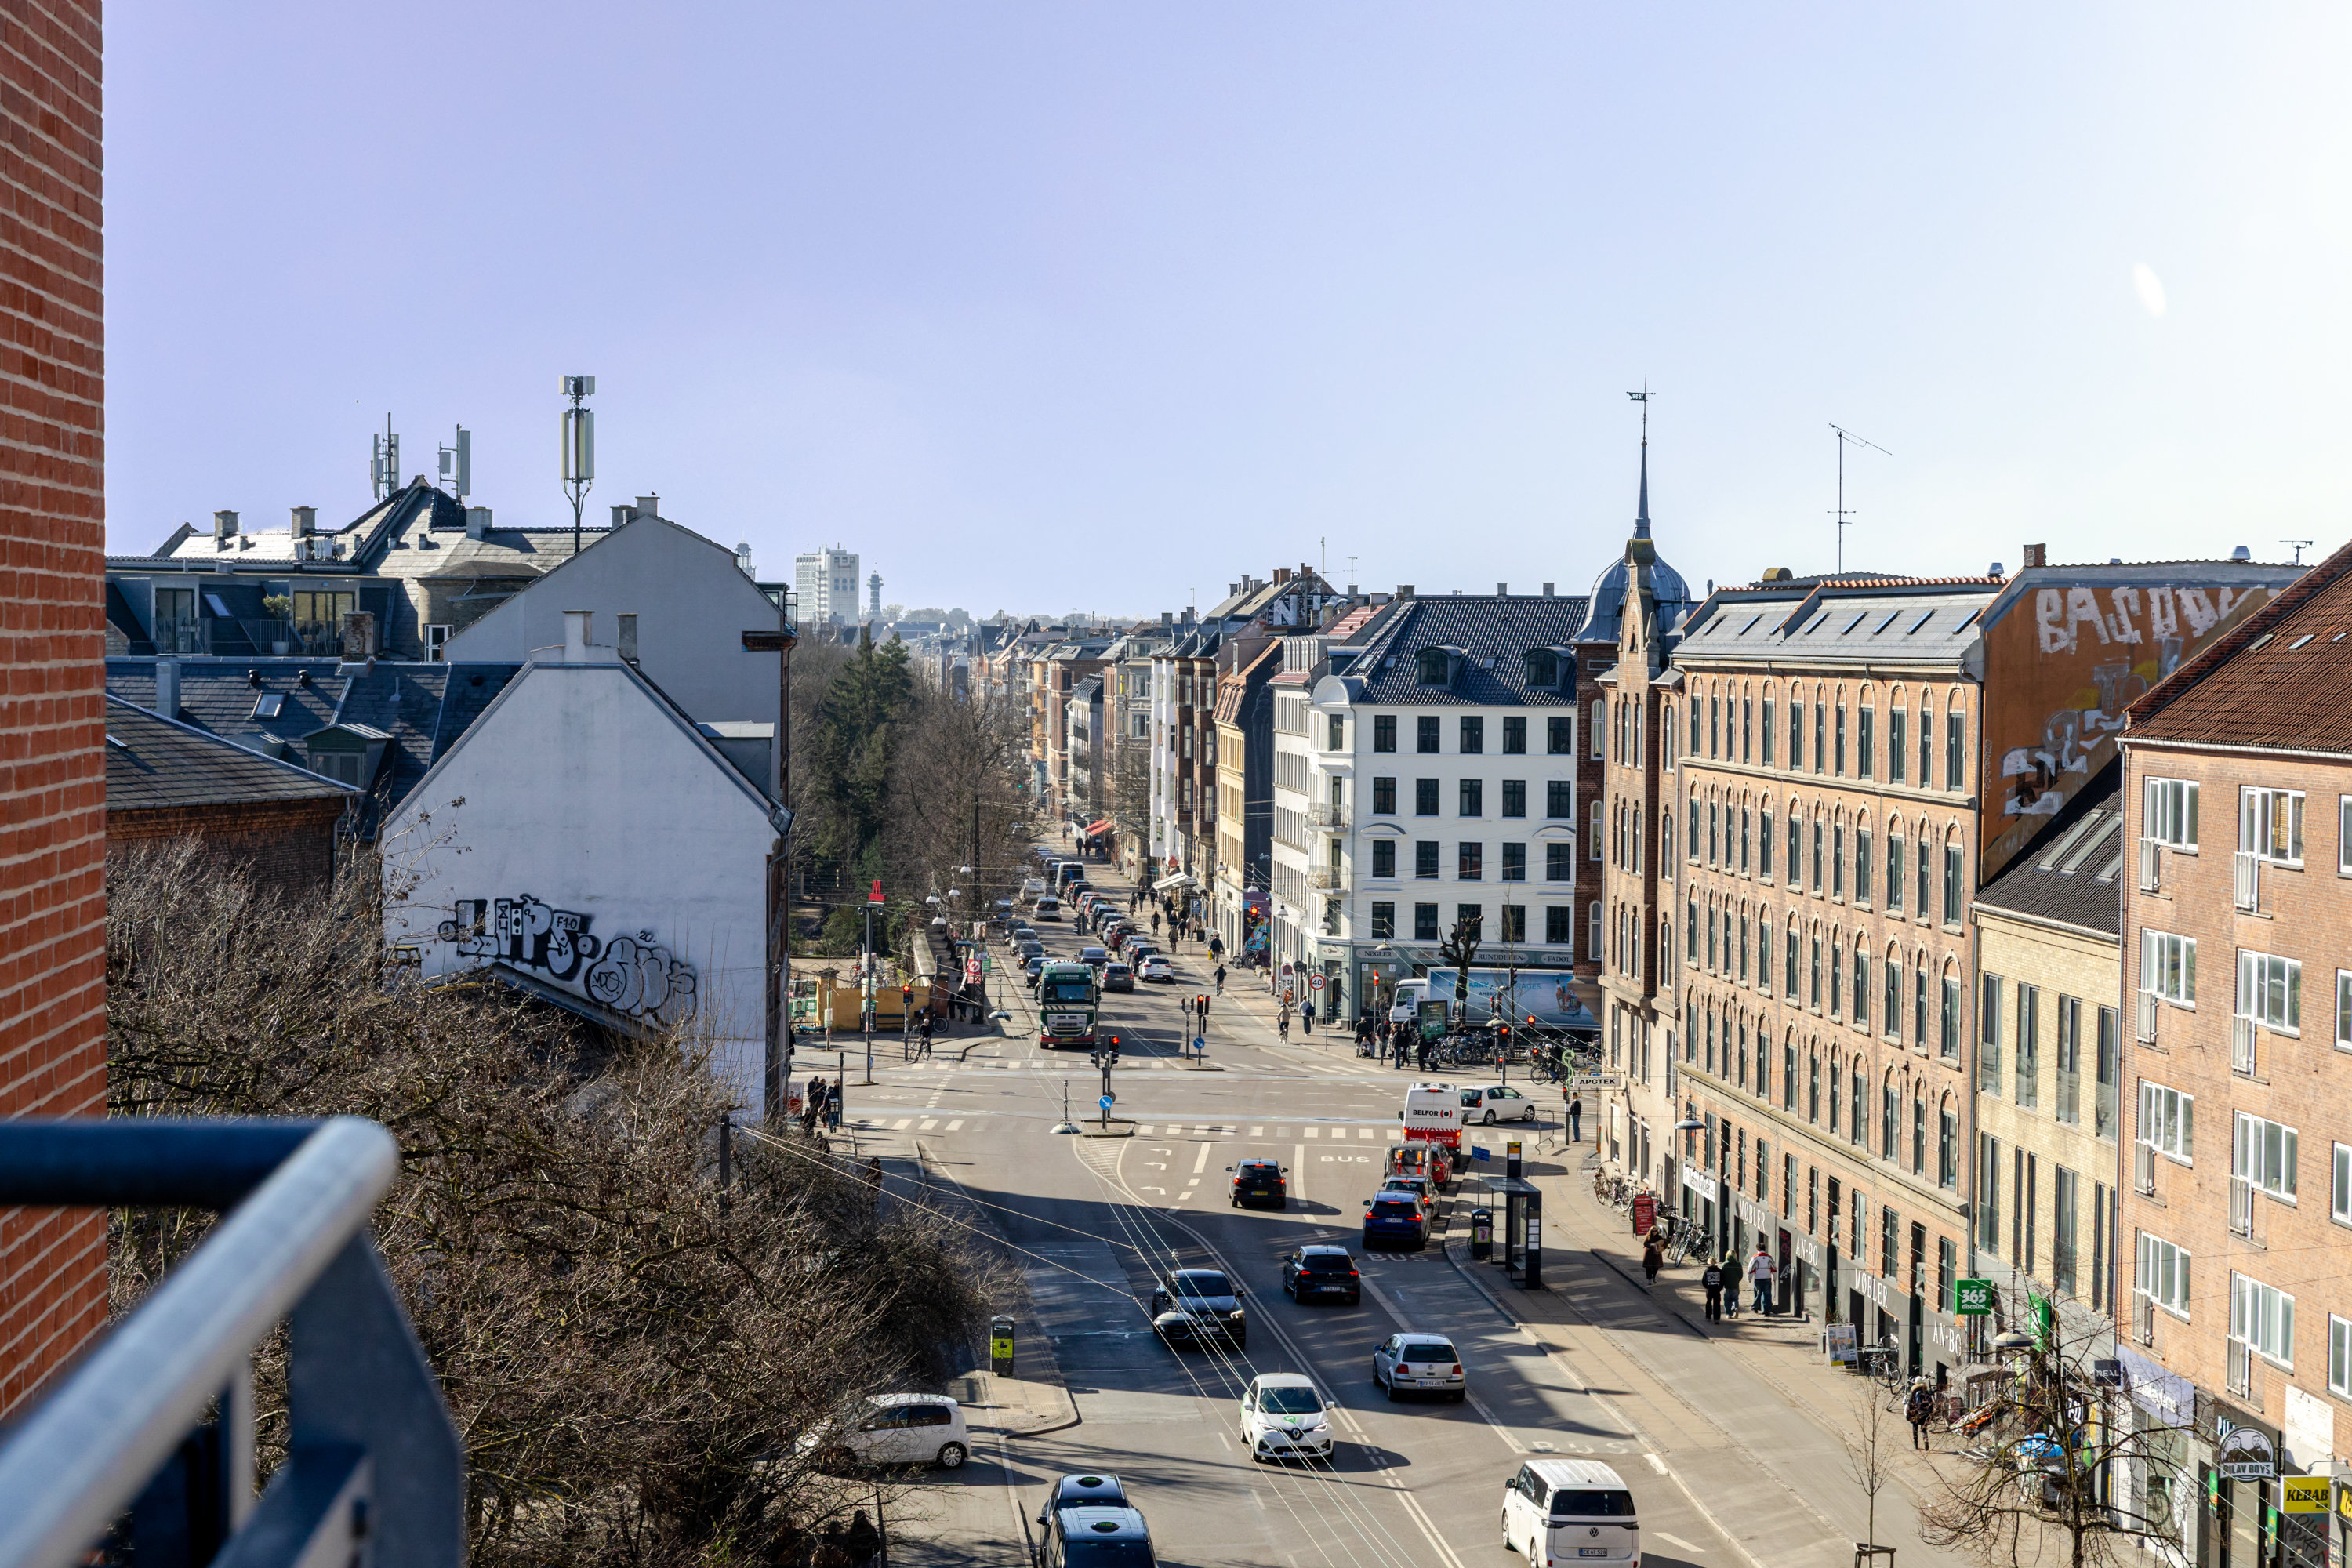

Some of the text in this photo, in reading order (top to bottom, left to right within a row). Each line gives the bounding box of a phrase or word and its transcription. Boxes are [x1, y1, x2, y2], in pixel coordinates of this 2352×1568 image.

[1739, 1199, 1766, 1232] MØBLER
[1367, 1253, 1429, 1262] BUS
[1855, 1268, 1889, 1308] MØBLER
[1962, 1289, 1987, 1304] 365
[1531, 1441, 1630, 1454] BUS
[2223, 1464, 2271, 1475] PILAV BOYS
[2286, 1489, 2329, 1501] KEBAB
